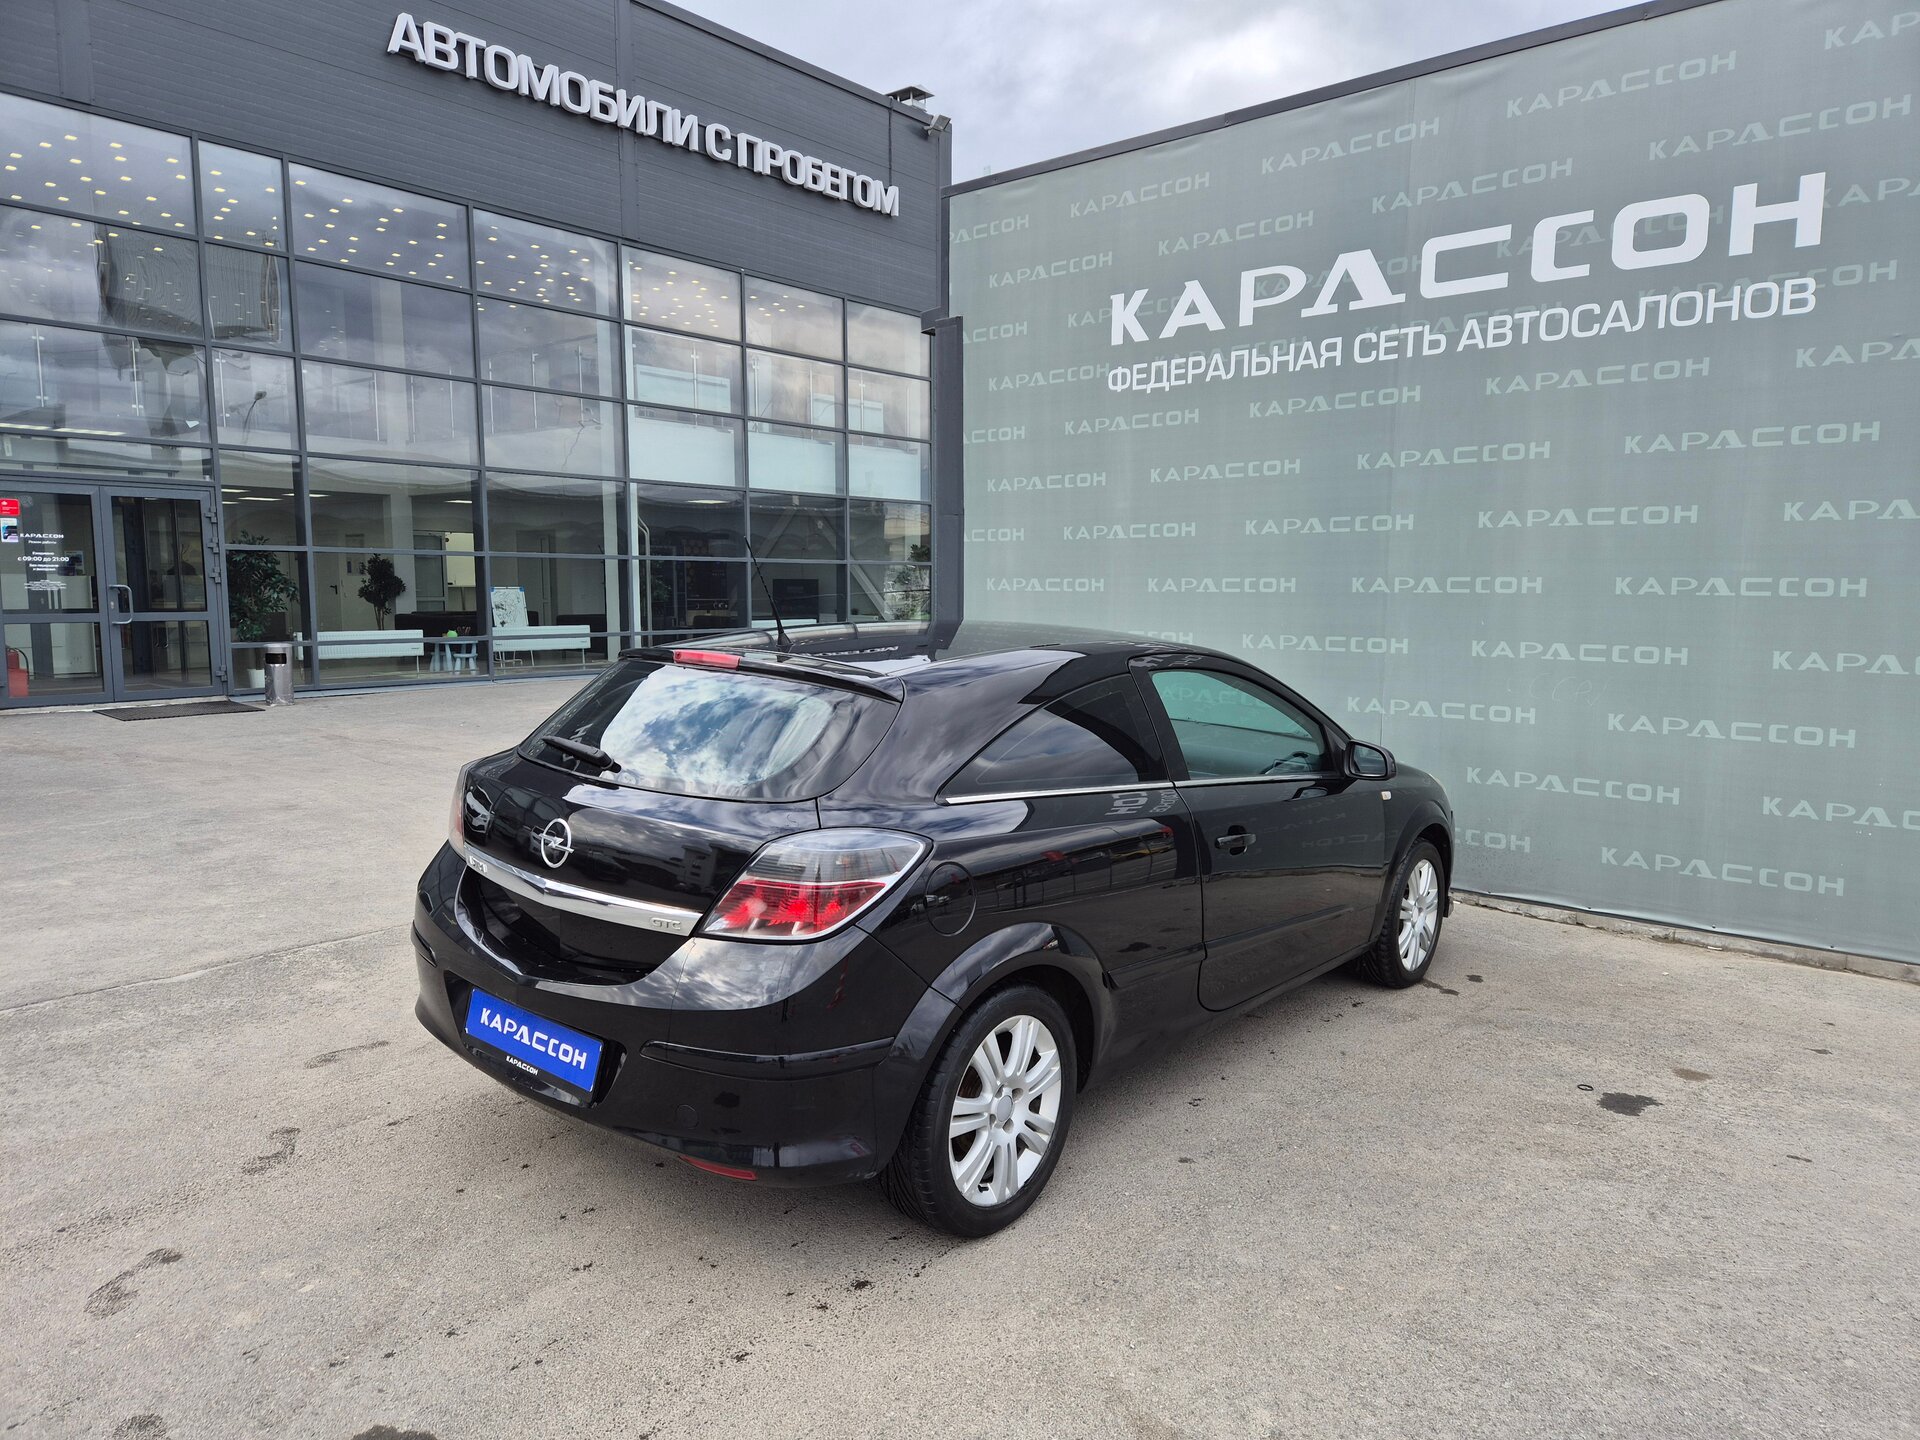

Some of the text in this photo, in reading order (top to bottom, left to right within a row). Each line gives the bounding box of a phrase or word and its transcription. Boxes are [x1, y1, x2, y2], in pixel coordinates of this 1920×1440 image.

[1506, 50, 1737, 119] КАРАССОН
[387, 12, 899, 217] АВТОМОБИЛИ С ПРОБЕГОМ
[1648, 94, 1911, 161] КАРАССОН
[1261, 117, 1440, 175] КАРАССОН
[1070, 171, 1211, 218] КАРАССОН
[1371, 158, 1573, 215] КАРАССОН
[1158, 210, 1314, 256] КАРАССОН
[989, 251, 1113, 288] КАРАССОН
[1110, 172, 1826, 346] КАРАССОН
[1107, 277, 1817, 394] ФЕДЕРАЛЬНАЯ СЕТЬ АВТОСАЛОНОВ
[1486, 357, 1710, 396] КАРАССОН
[1249, 385, 1421, 419] КАРАССОН
[1064, 408, 1200, 436] КАРАССОН
[1624, 421, 1880, 454] КАРАССОН
[1150, 458, 1300, 483] КАРАССОН
[1357, 441, 1551, 471] КАРАССОН
[987, 471, 1106, 492] КАРАССОН
[1063, 522, 1196, 540] КАРАССОН
[1245, 513, 1414, 536] КАРАССОН
[1478, 505, 1698, 529] КАРАССОН
[986, 577, 1105, 592] КАРАССОН
[1148, 577, 1296, 593] КАРАССОН
[1352, 576, 1542, 593] КАРАССОН
[1615, 576, 1867, 598] КАРАССОН
[1242, 633, 1408, 654] КАРАССОН
[1471, 639, 1688, 665] КАРАССОН
[1772, 651, 1920, 675] КАРА
[1347, 696, 1536, 725] КАРАССОН
[1608, 713, 1855, 748] КАРАССОН
[1466, 766, 1680, 805] КАРАССОН
[1455, 827, 1531, 853] СОН
[1601, 847, 1844, 896] КАРАССОН
[480, 1007, 588, 1070] КАРАССОН
[506, 1055, 539, 1076] КАРАССОН
